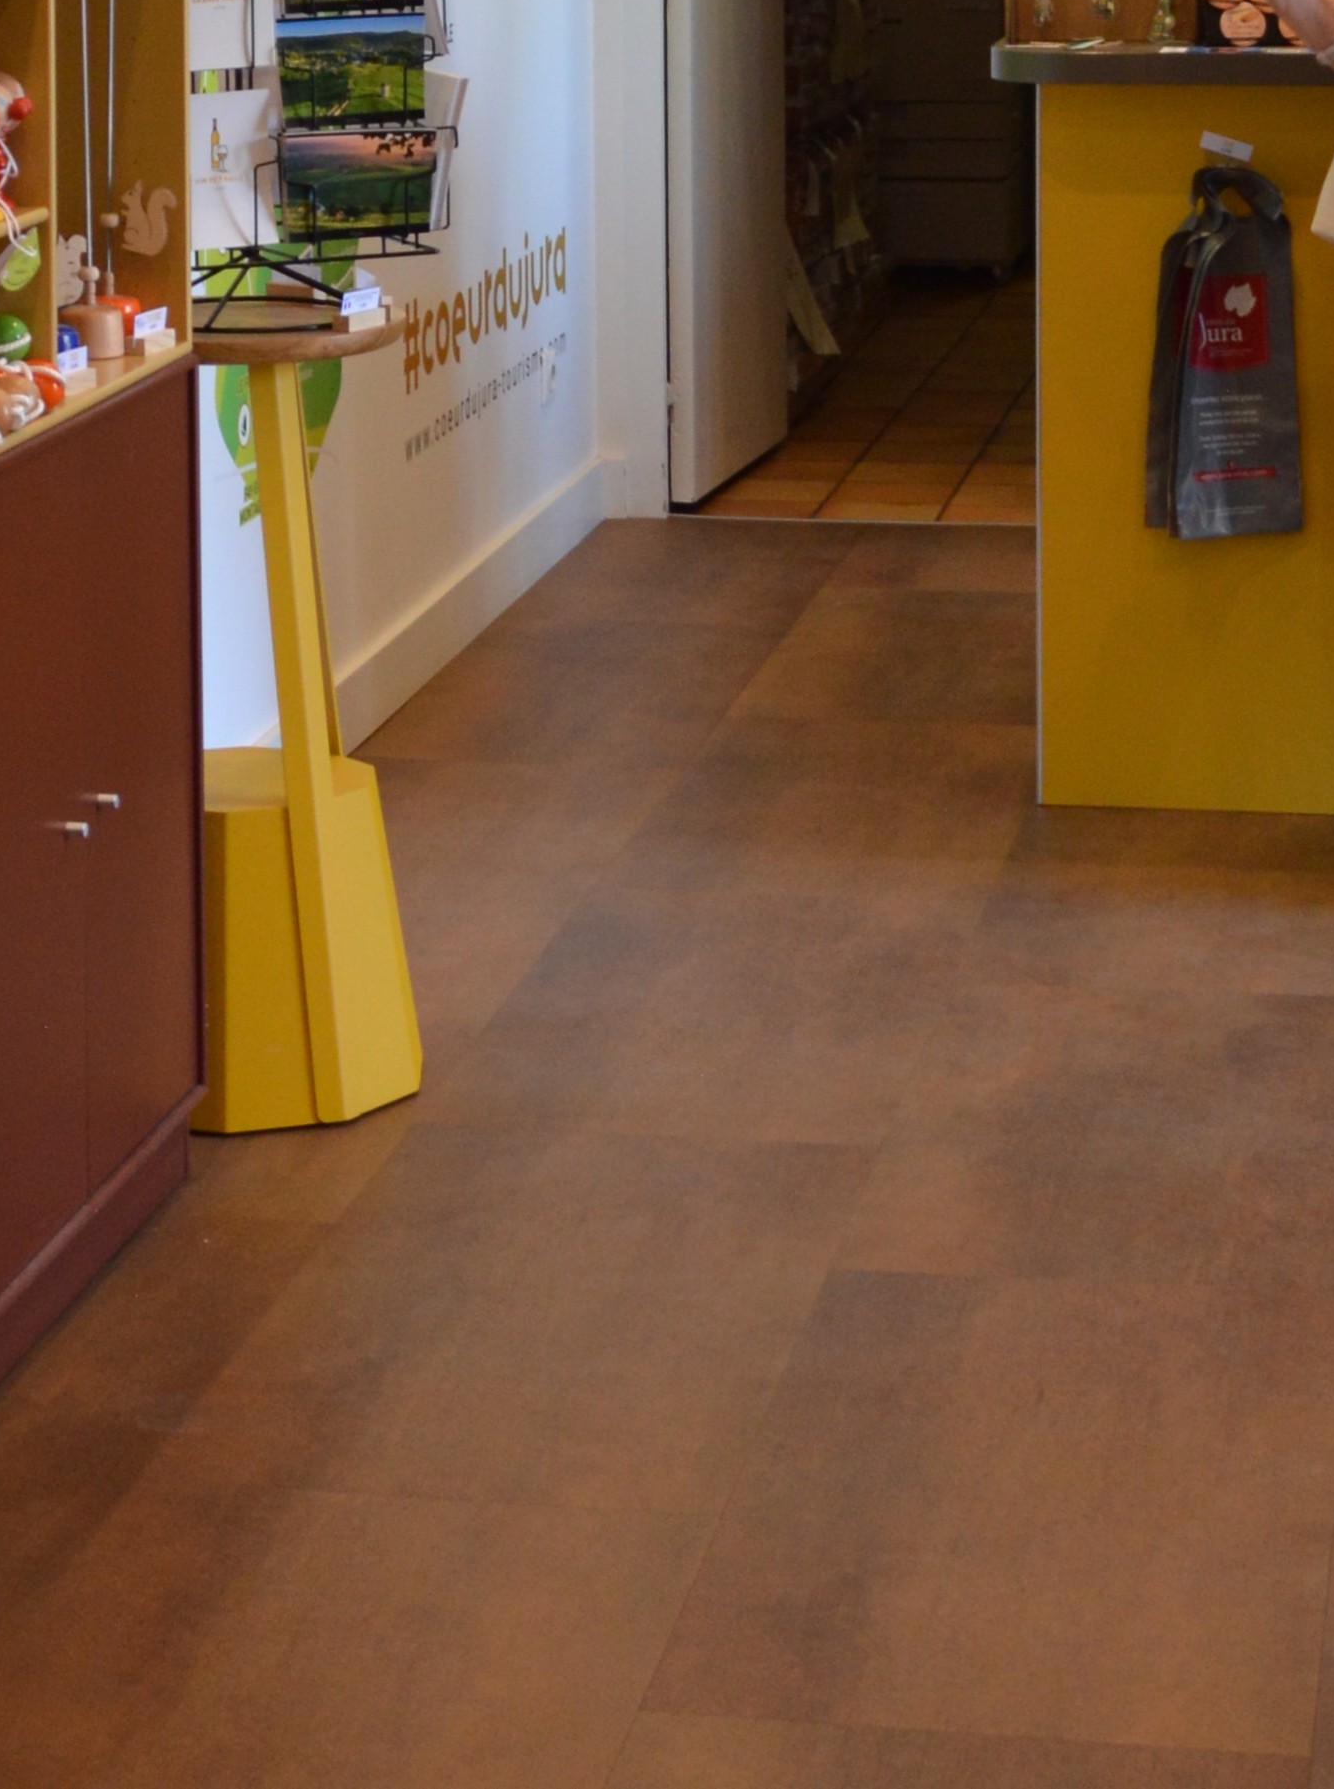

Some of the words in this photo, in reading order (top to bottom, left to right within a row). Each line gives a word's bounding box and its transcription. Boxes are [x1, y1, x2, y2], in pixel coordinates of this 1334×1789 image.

[403, 226, 567, 396] #coeurdujura
[1198, 312, 1243, 350] Jura
[405, 332, 567, 462] www.coeurdujura-tourismecom
